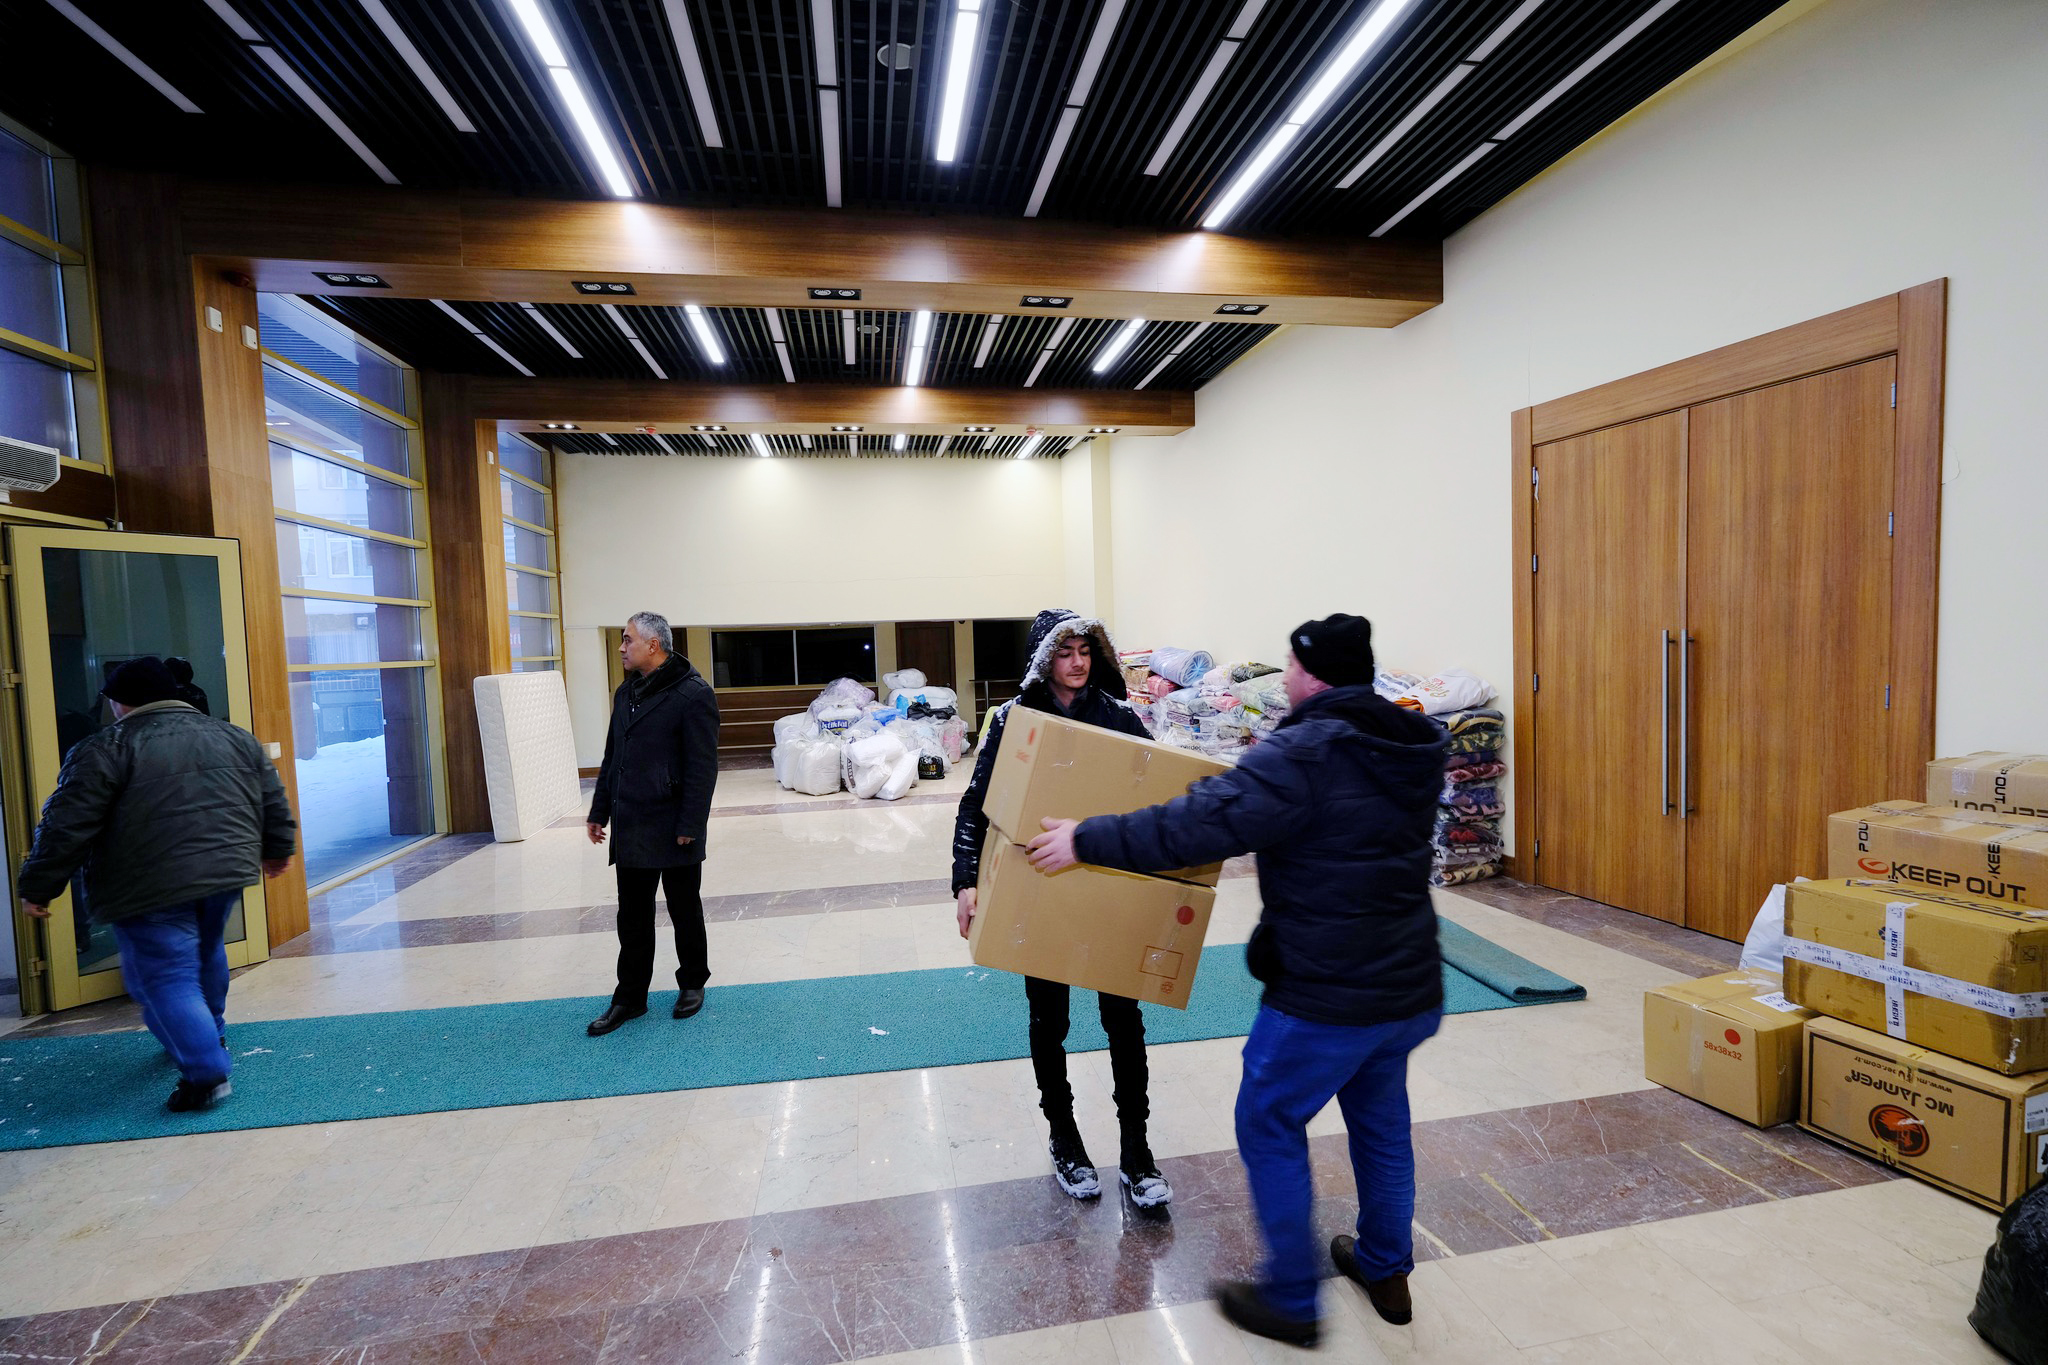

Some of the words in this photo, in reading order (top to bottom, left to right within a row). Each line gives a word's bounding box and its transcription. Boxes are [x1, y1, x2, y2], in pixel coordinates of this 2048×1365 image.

[1891, 861, 1961, 888] KEEP
[1966, 876, 2027, 903] OUT
[1703, 1040, 1742, 1061] 58x38x32
[1925, 1096, 1954, 1117] MC
